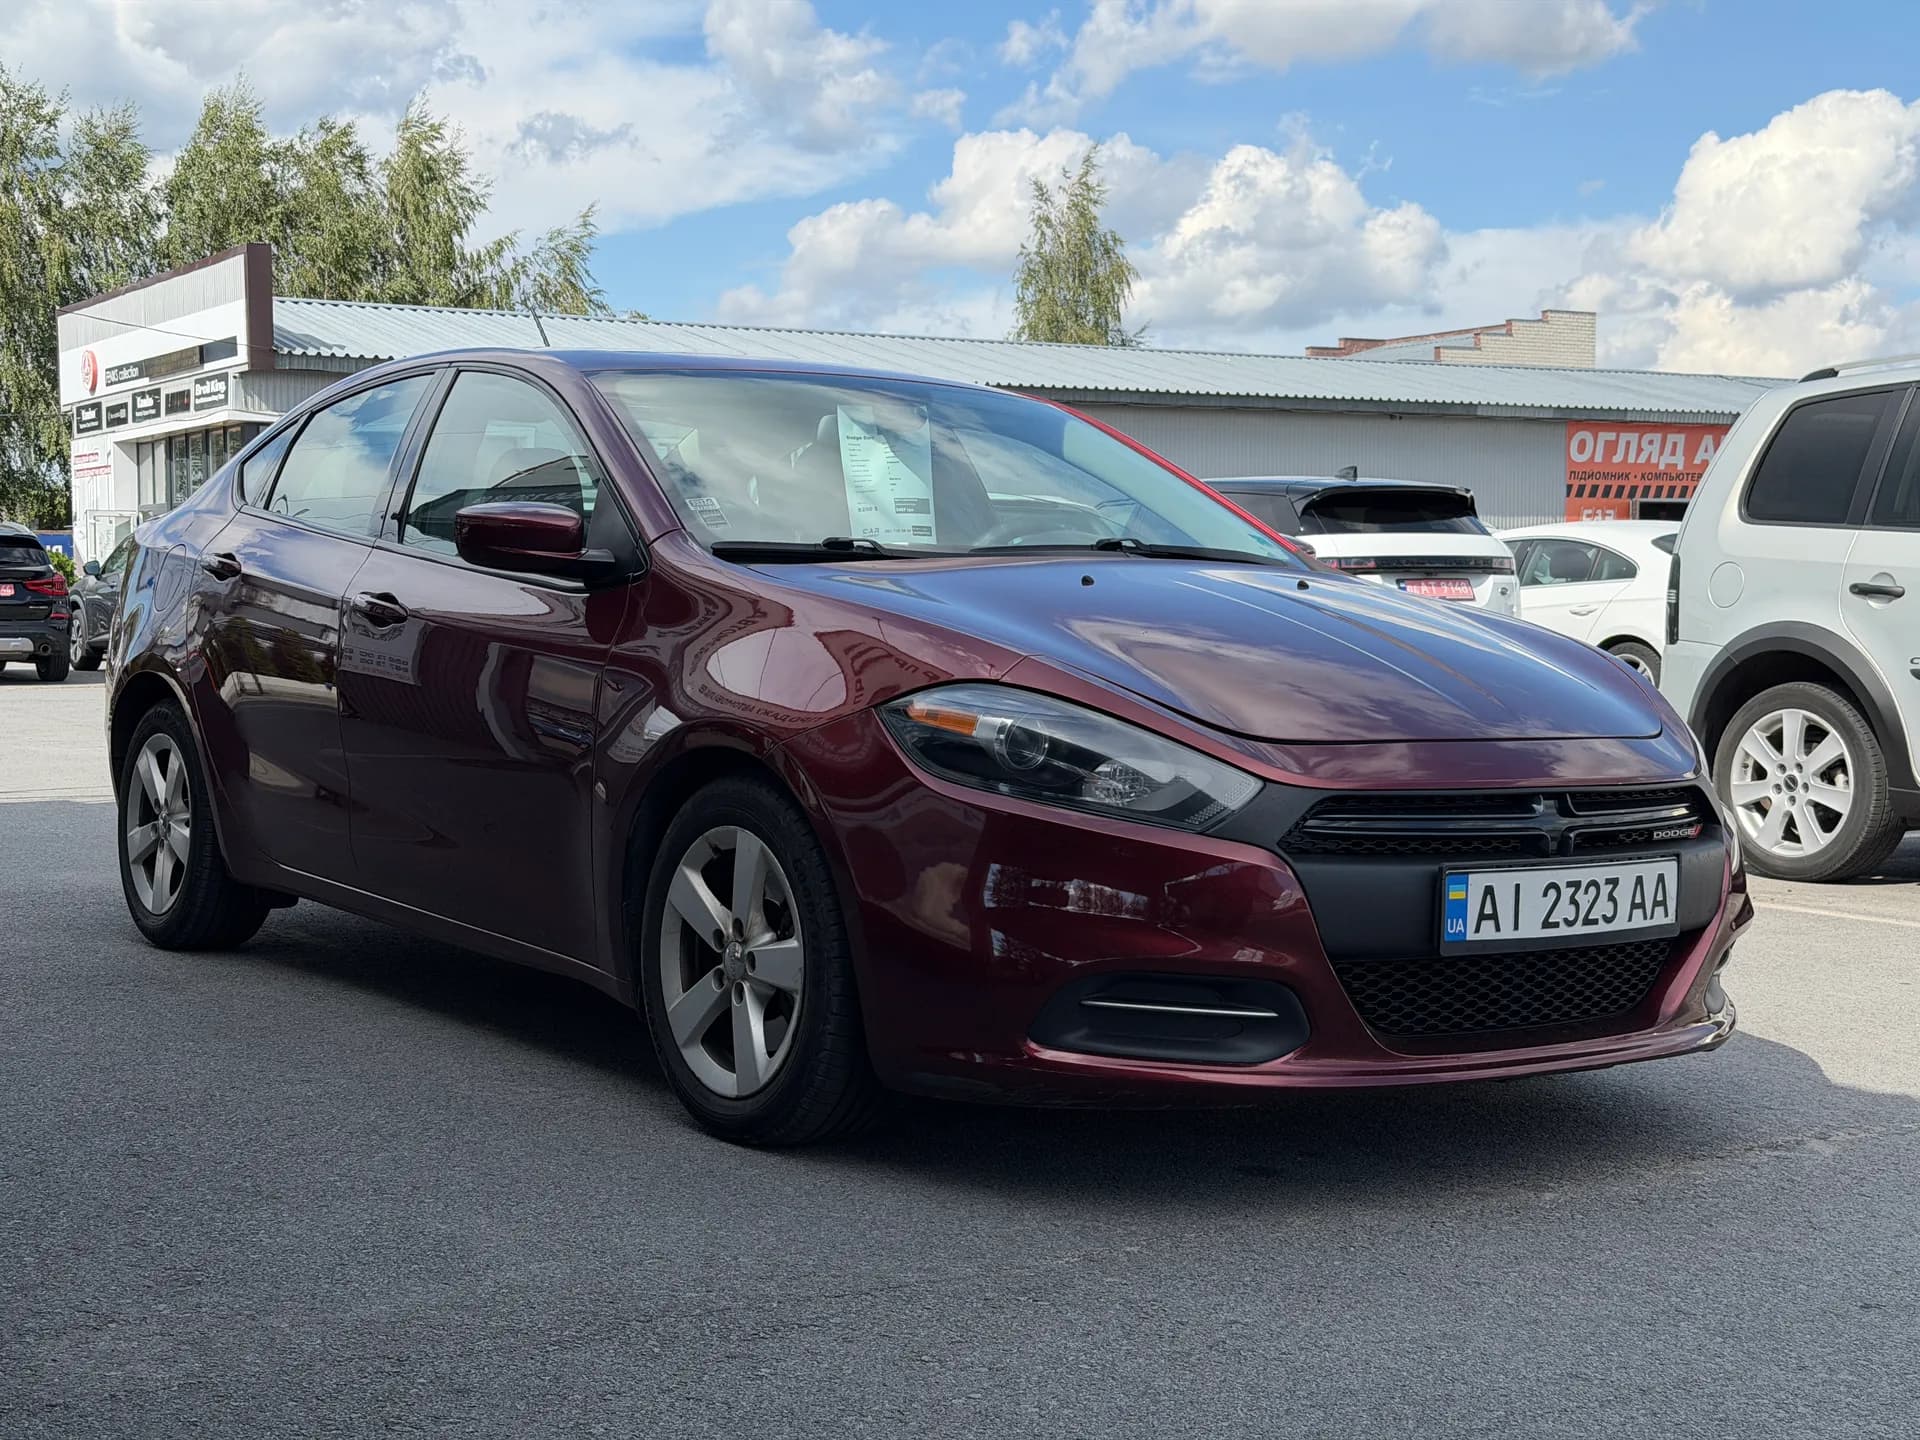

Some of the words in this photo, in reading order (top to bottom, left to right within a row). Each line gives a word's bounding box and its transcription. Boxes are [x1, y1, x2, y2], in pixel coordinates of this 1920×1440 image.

[195, 380, 211, 396] Broil
[1569, 430, 1686, 470] ОГЛЯД
[1693, 433, 1727, 466] А
[1569, 470, 1631, 482] ПІДЙОМНИК
[1653, 828, 1696, 839] DODGE
[1473, 882, 1521, 934] AI
[1541, 876, 1620, 930] 2323
[1627, 872, 1670, 923] AA
[1447, 918, 1465, 934] UA
